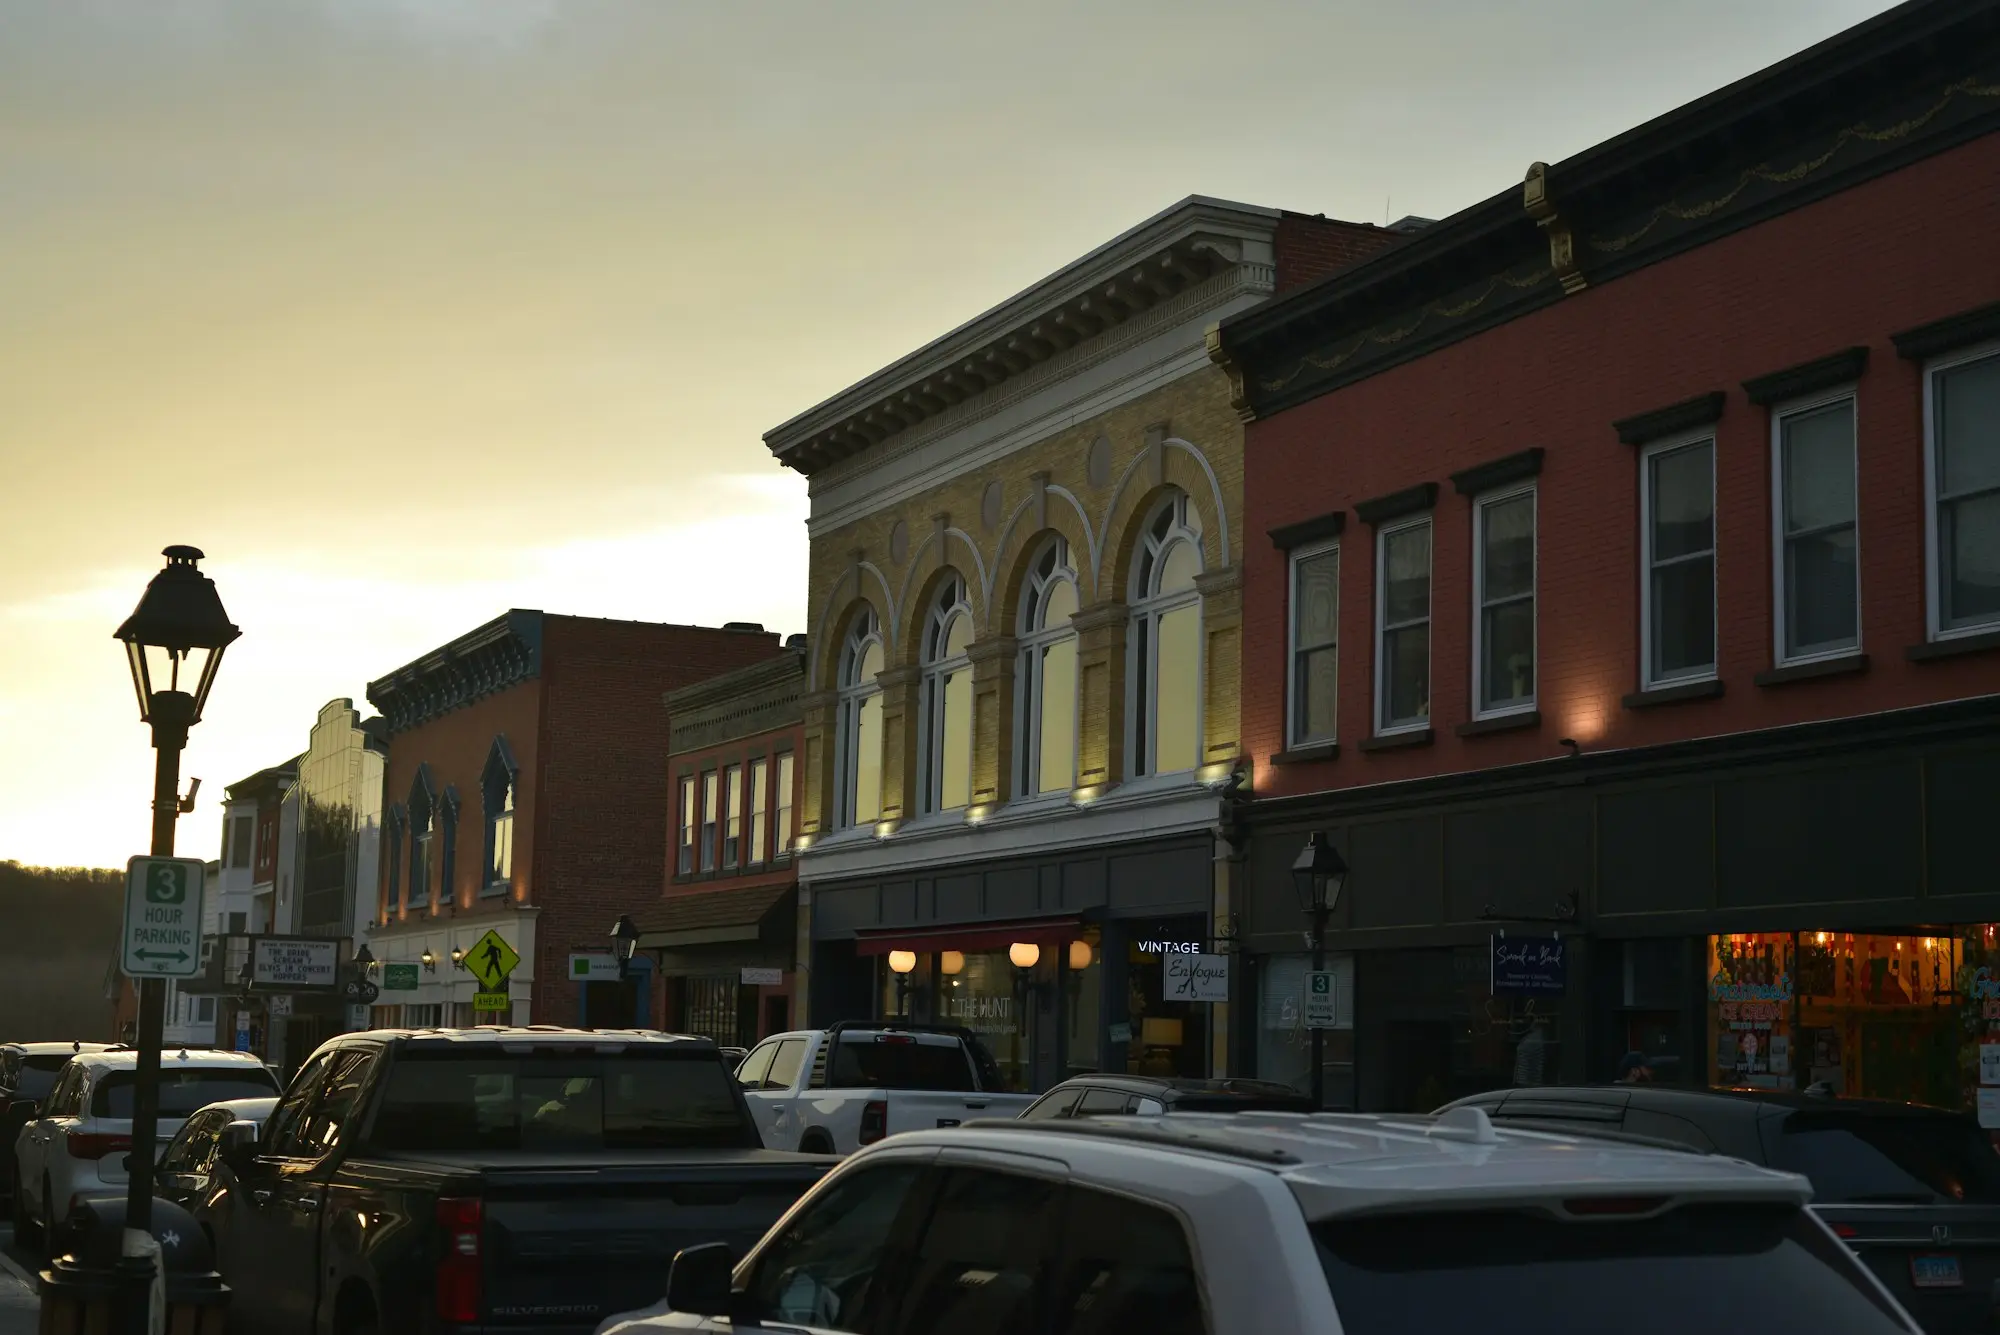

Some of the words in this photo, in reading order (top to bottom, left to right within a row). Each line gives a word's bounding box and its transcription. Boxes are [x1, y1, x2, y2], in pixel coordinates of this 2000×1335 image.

[156, 868, 176, 900] 3
[145, 908, 183, 924] HOUR
[134, 928, 191, 945] PARKING
[268, 948, 283, 956] THE
[1138, 940, 1200, 954] VINTAGE
[259, 964, 281, 972] ELVIS
[285, 964, 294, 973] IN
[298, 966, 331, 974] CONCERT
[273, 972, 307, 981] HOPPERS
[1316, 976, 1326, 992] 3
[477, 996, 505, 1008] AHEAD
[958, 997, 978, 1018] THE
[1307, 1004, 1333, 1013] PARKING
[1718, 1003, 1737, 1020] ICE
[1741, 1003, 1784, 1020] CREAM
[491, 1304, 599, 1316] SILVERADO
